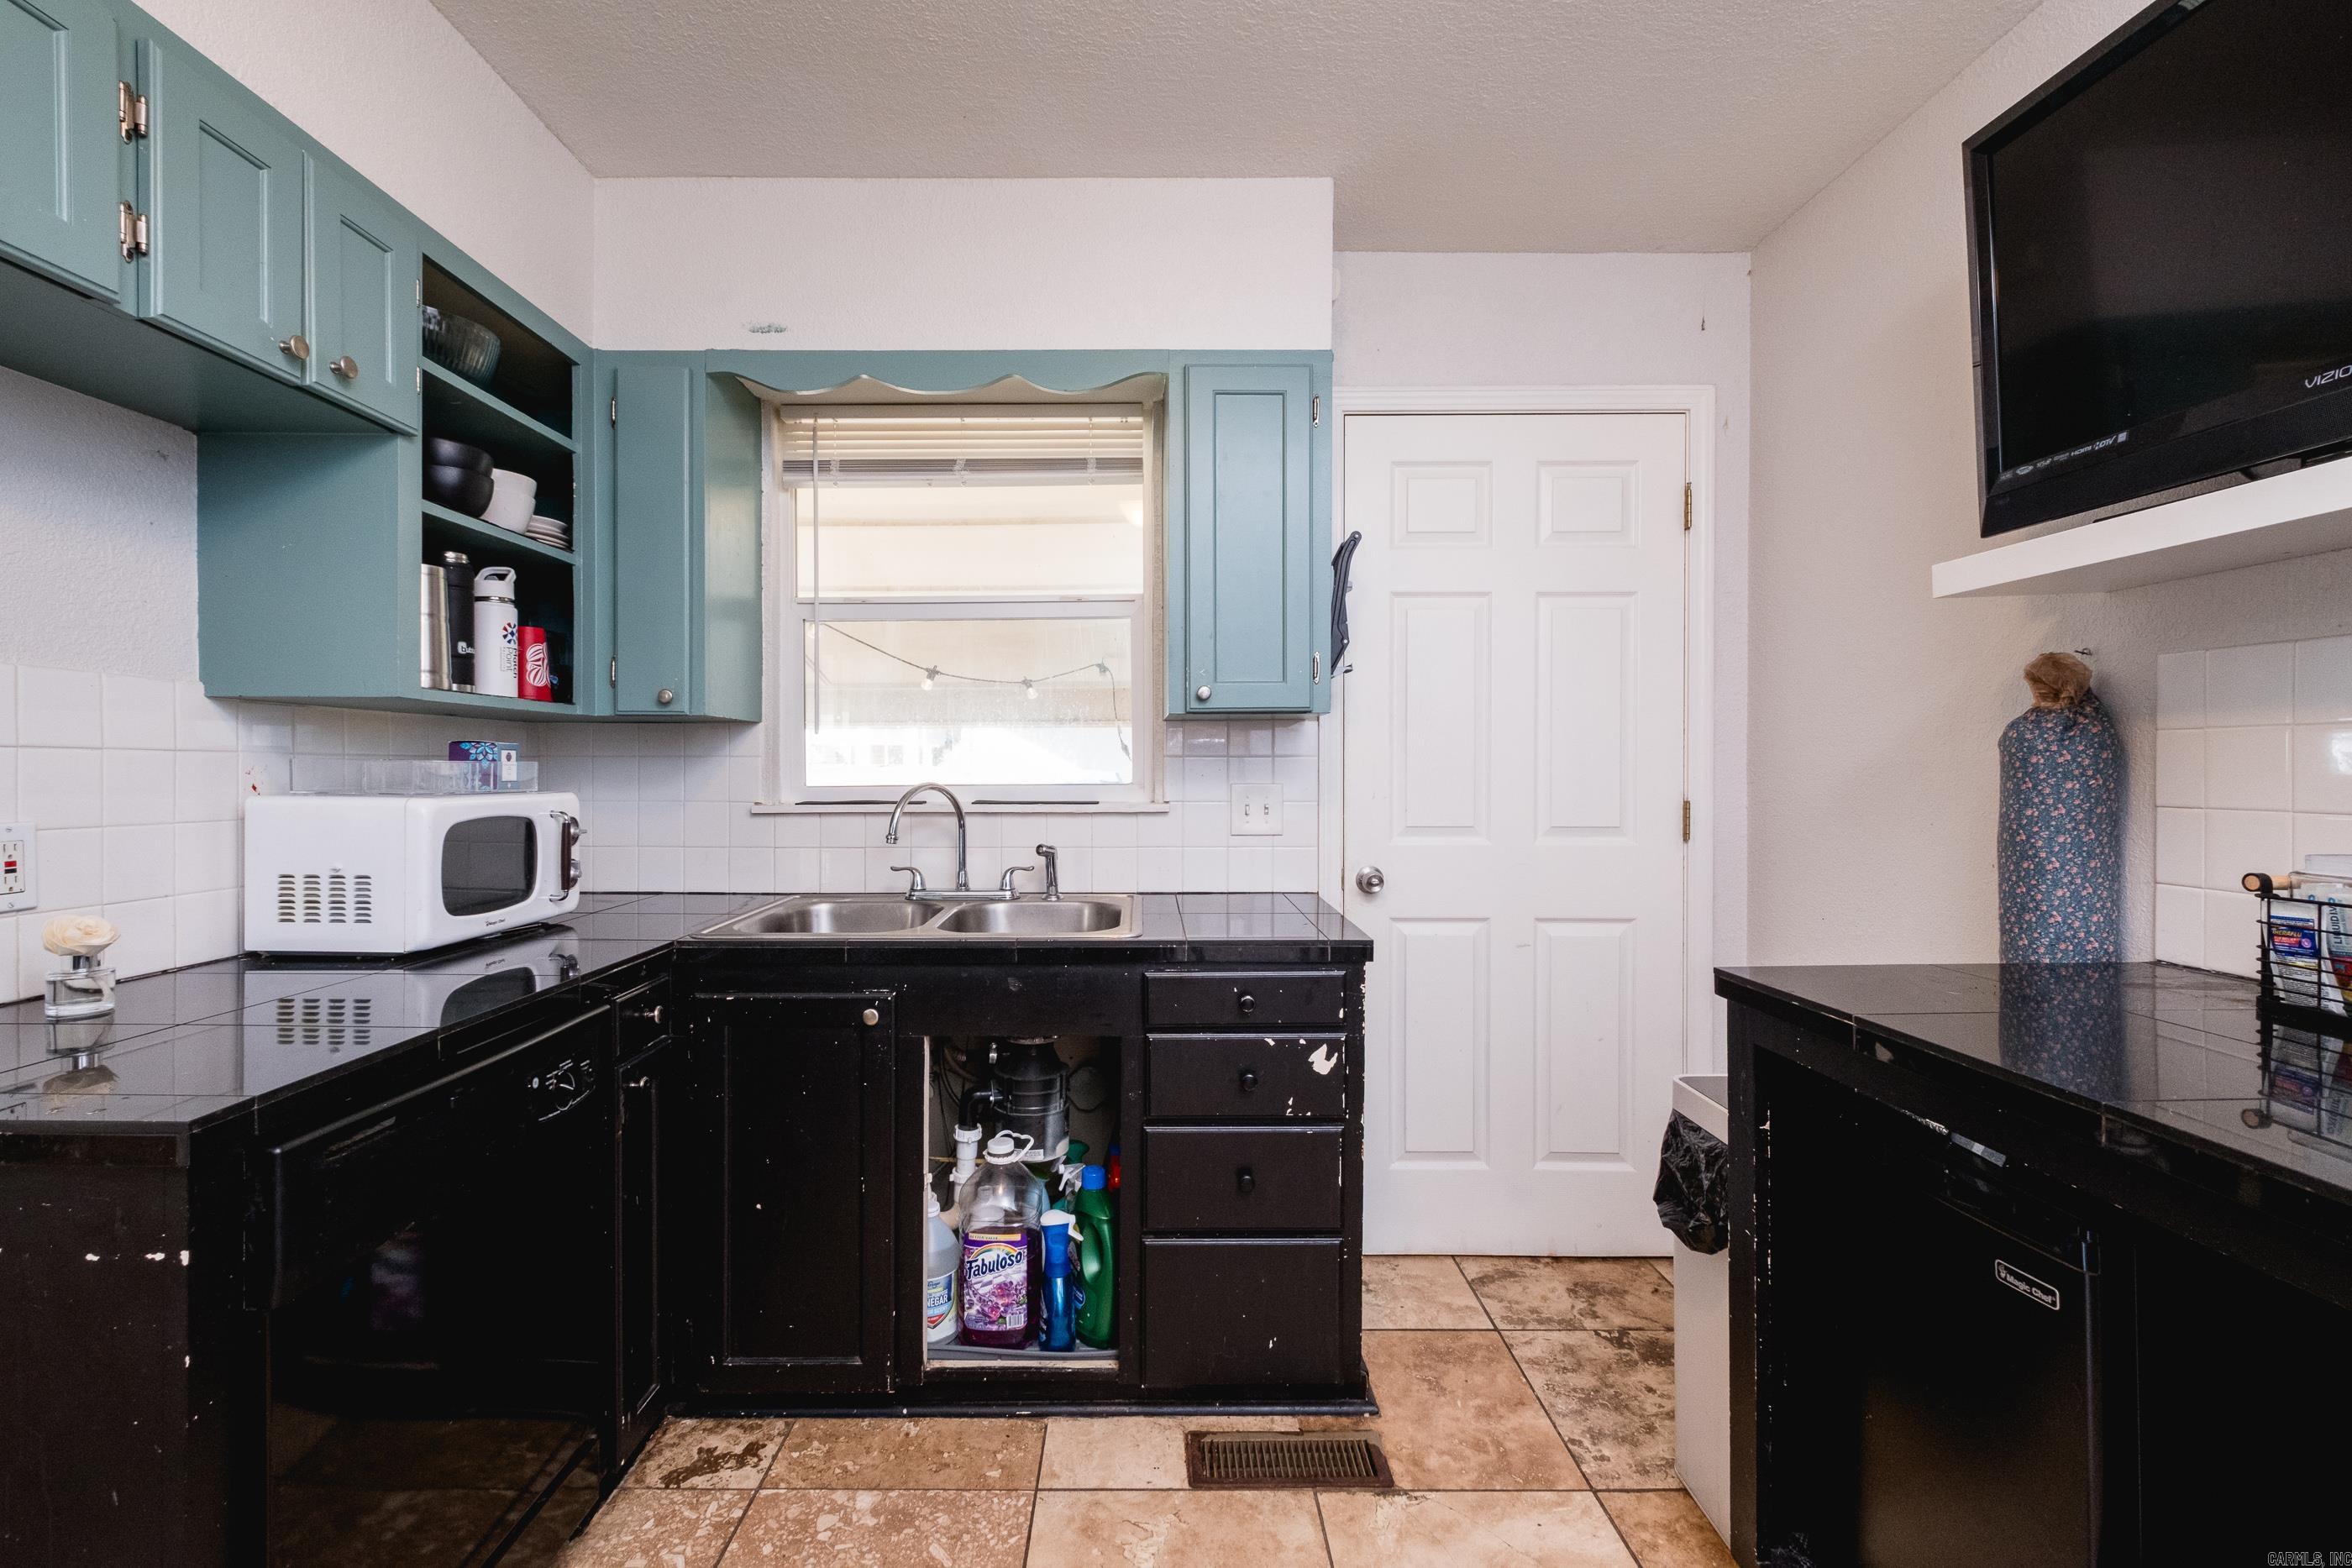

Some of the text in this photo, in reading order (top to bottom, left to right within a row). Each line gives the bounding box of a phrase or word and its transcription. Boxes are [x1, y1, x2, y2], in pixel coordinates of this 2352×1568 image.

[2305, 364, 2352, 388] VIZIO
[966, 1250, 1023, 1280] Fabuloso
[927, 1294, 948, 1308] NEGAR
[2006, 1272, 2053, 1303] Magic Chef
